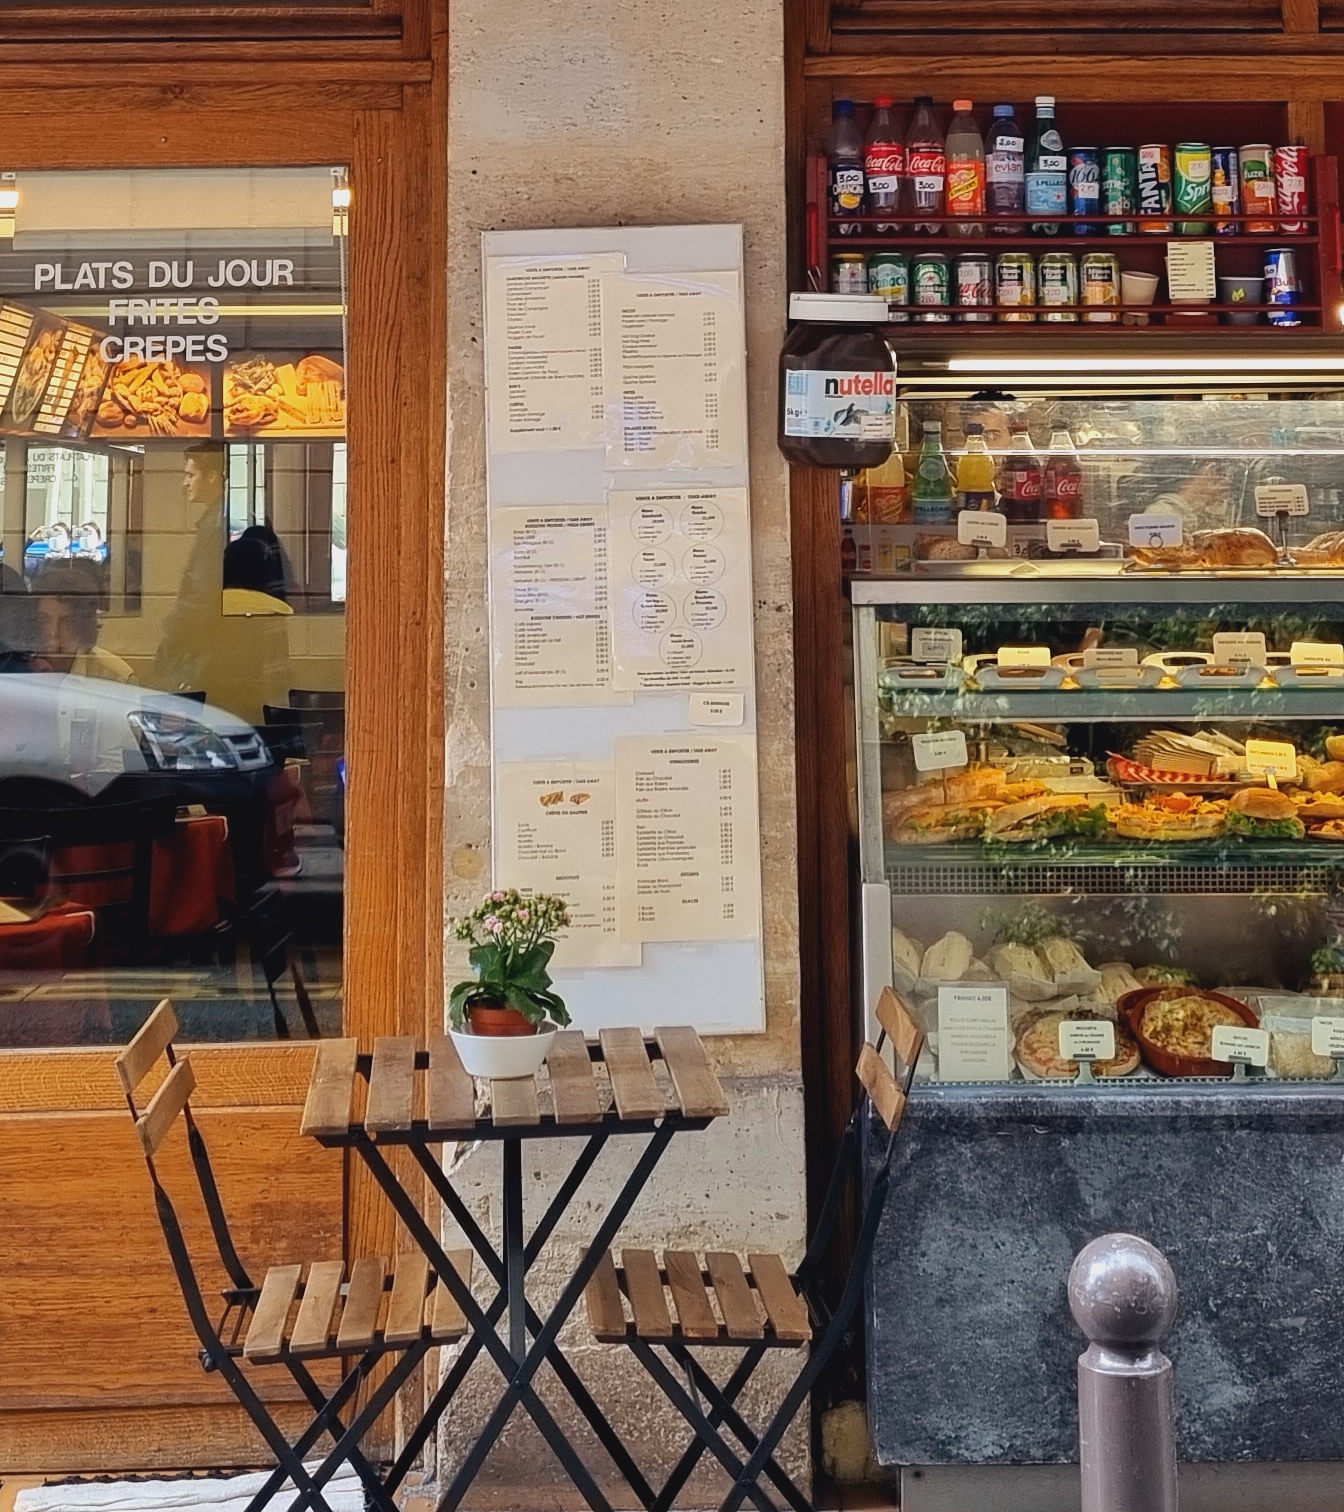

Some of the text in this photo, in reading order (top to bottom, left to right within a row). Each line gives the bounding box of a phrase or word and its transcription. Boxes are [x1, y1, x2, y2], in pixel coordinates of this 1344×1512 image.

[994, 163, 1023, 173] evian
[35, 259, 294, 290] PLATS DU JOUR
[109, 297, 219, 325] FRITES
[100, 334, 228, 363] CREPES
[825, 372, 893, 395] nutella
